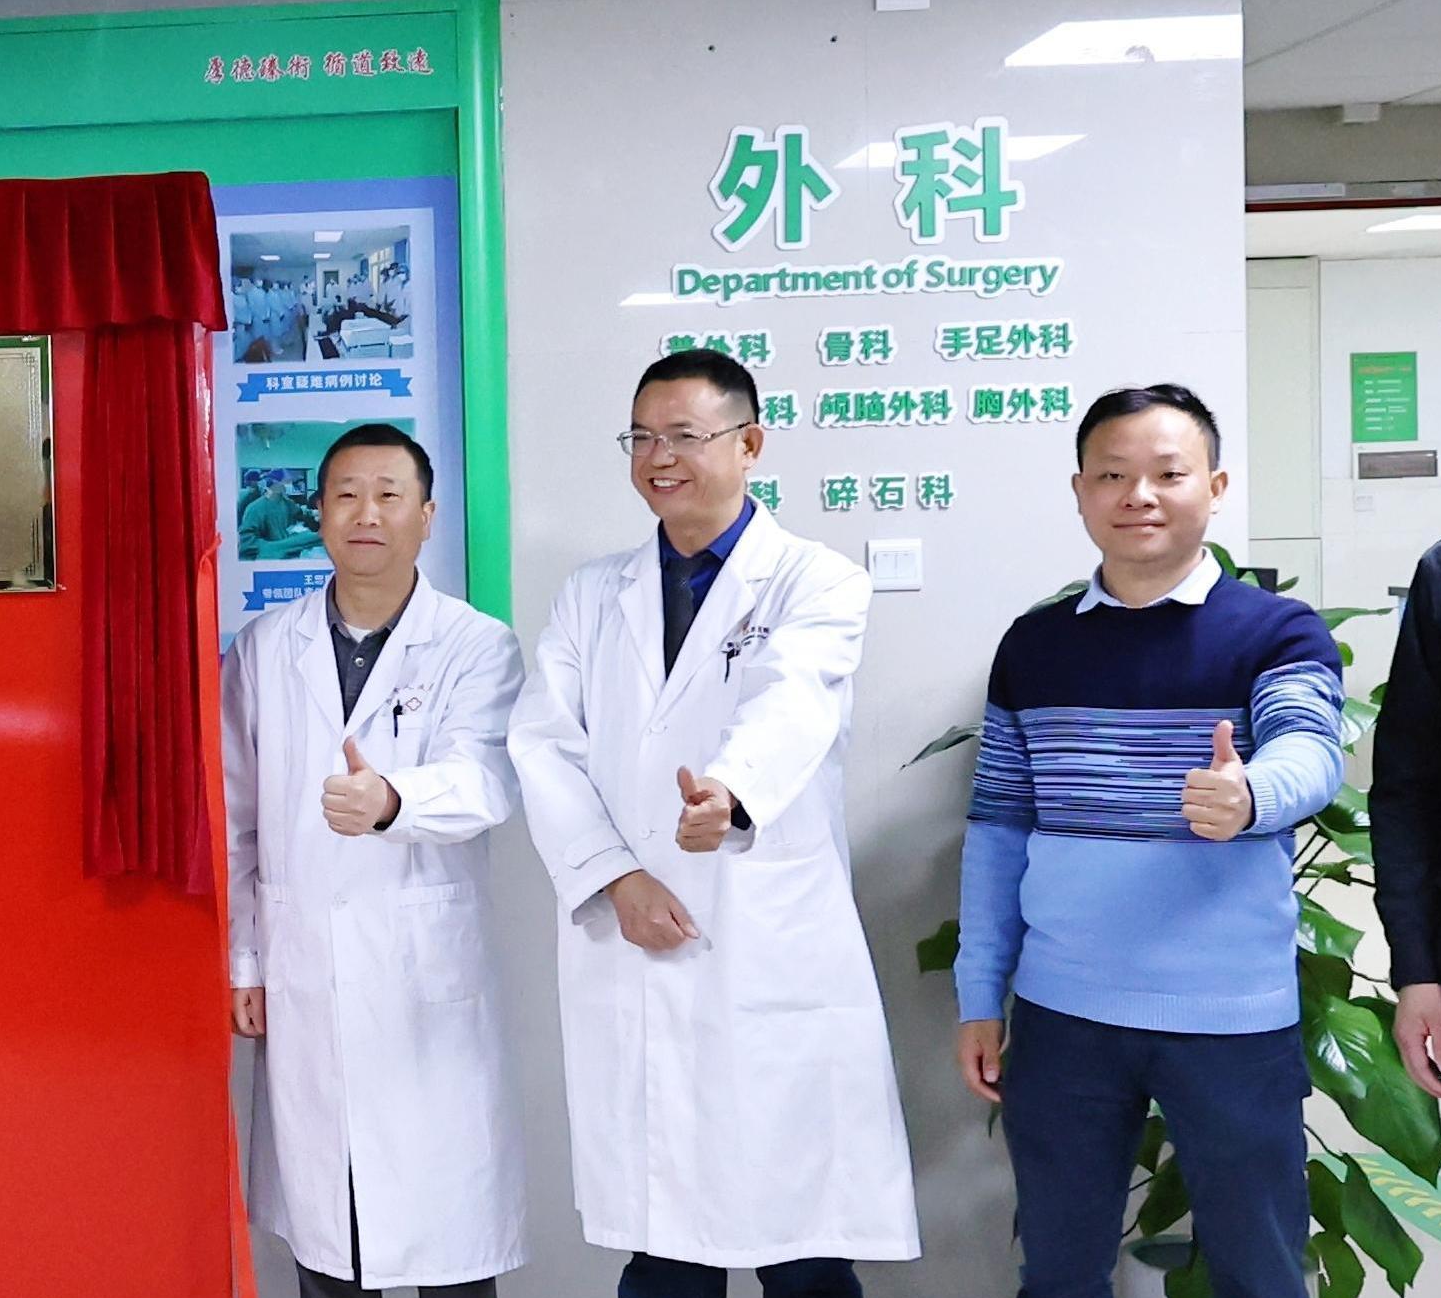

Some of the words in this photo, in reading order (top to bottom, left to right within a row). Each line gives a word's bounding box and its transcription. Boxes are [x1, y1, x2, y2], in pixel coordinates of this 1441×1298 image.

[715, 125, 1019, 245] 外科
[677, 265, 877, 302] Department
[881, 260, 917, 289] of
[925, 259, 1061, 296] Surgery
[824, 328, 894, 362] 骨科
[940, 321, 1074, 357] 手足外科
[265, 372, 384, 391] 科室疑难病例讨论
[818, 389, 953, 424] 颅脑外科
[972, 385, 1074, 419] 胸外科
[826, 474, 955, 508] 碎石科
